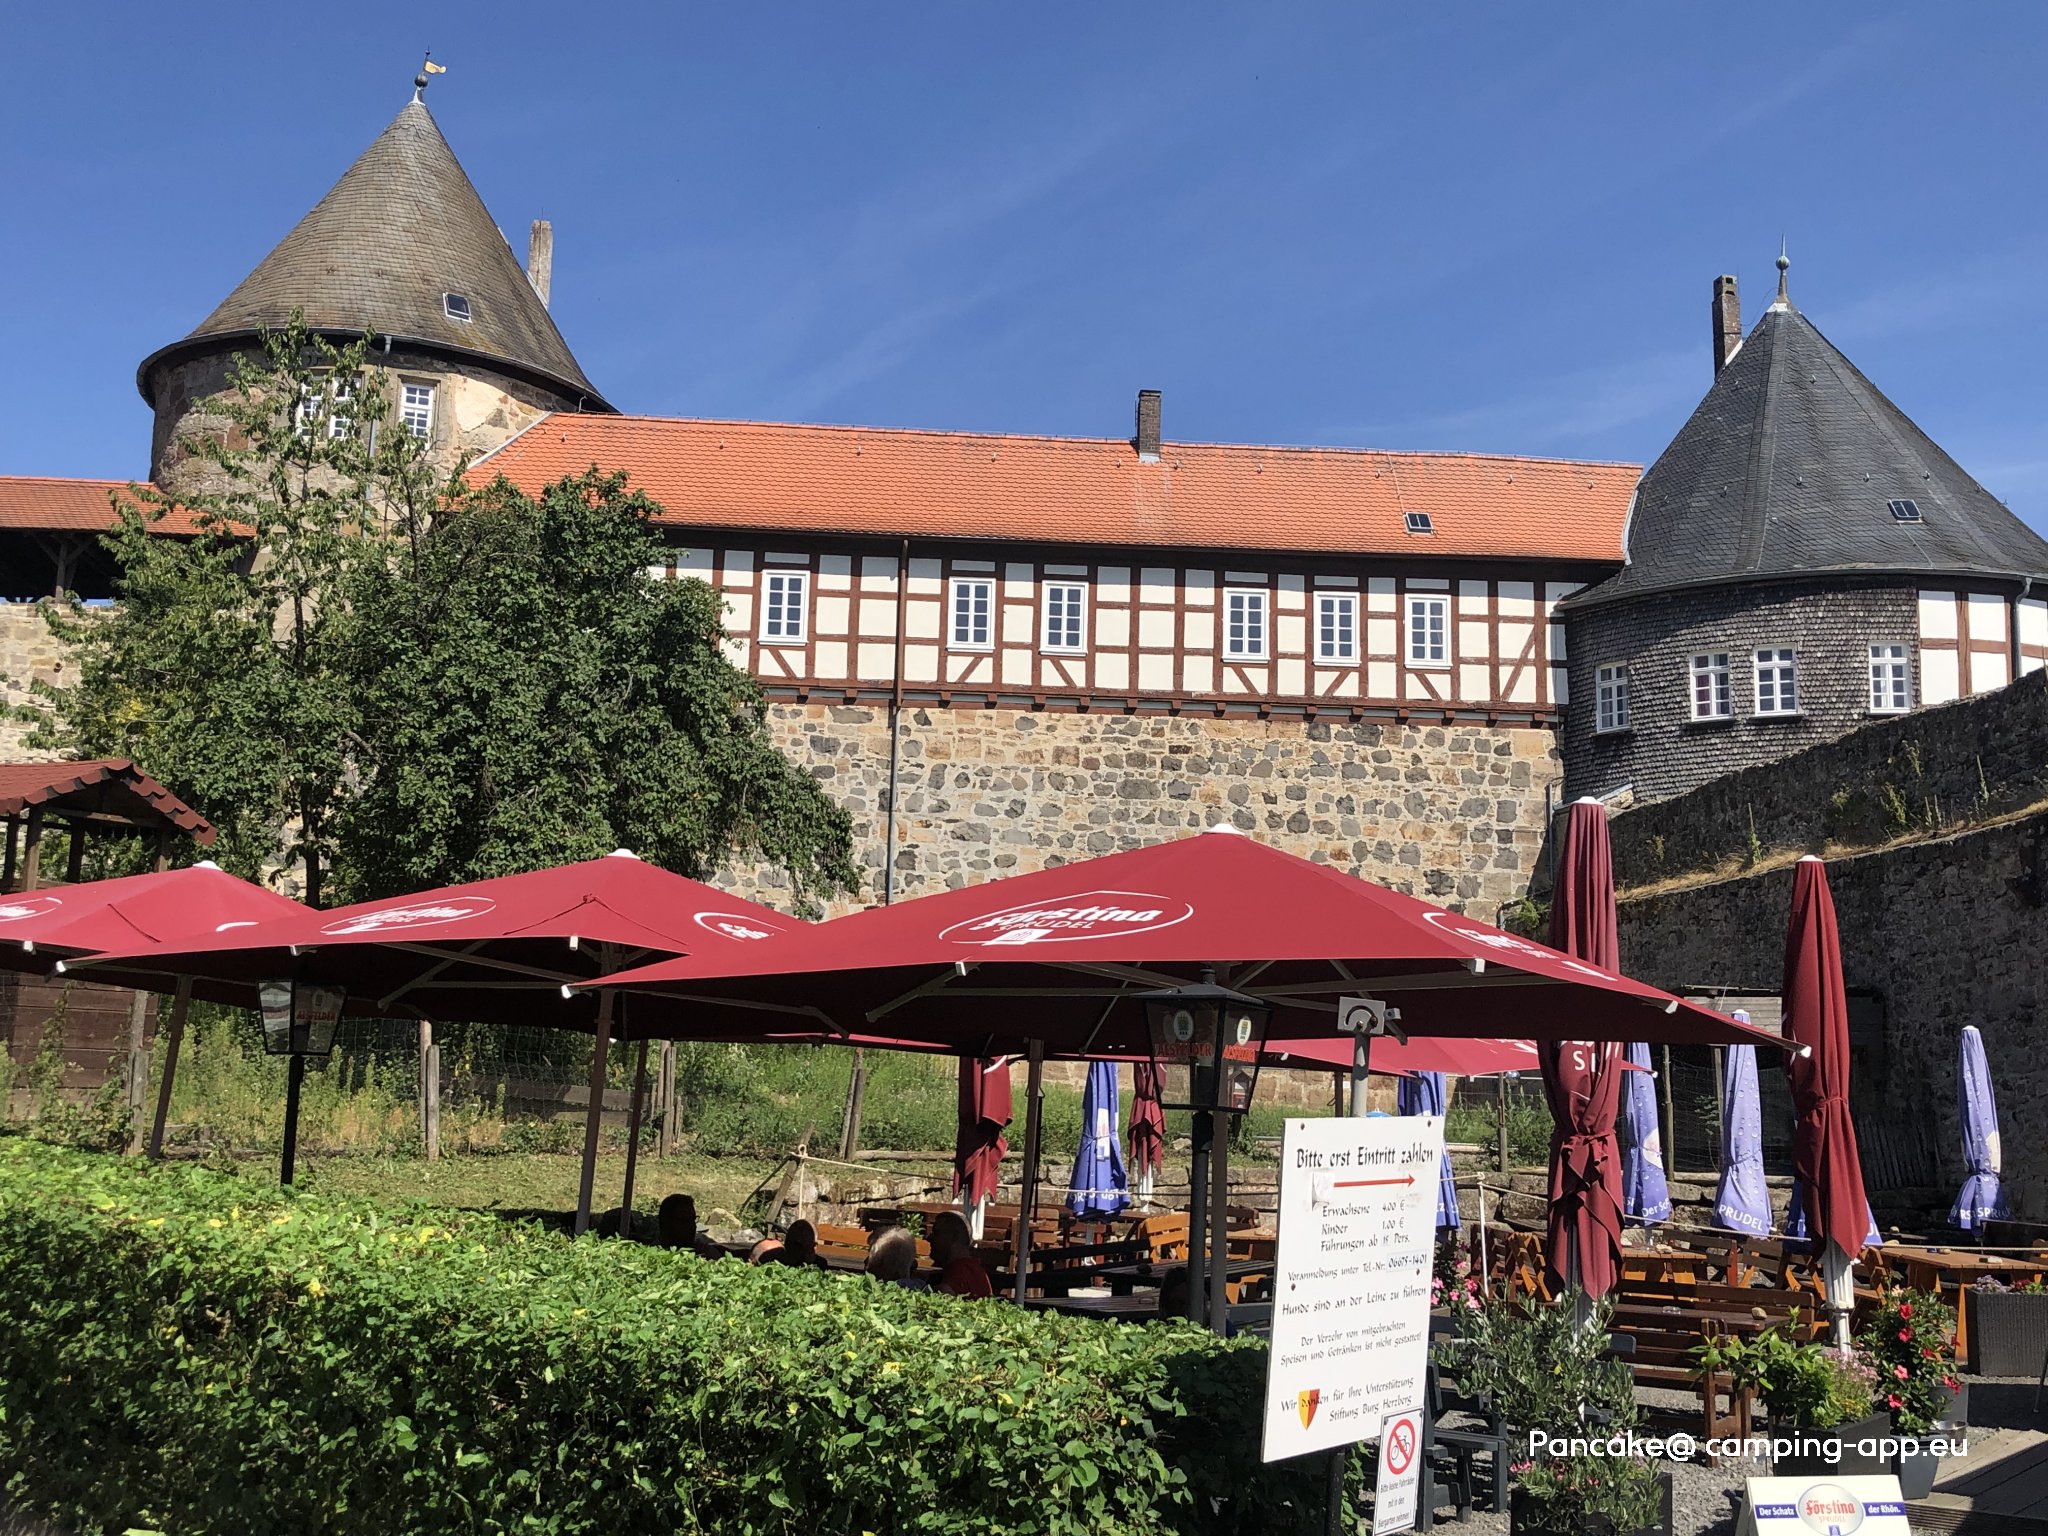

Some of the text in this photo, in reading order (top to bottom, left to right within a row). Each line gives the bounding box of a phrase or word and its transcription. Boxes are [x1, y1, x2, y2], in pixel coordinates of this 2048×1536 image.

[1296, 1141, 1433, 1168] Bitte erst Eintritt zahlen
[1322, 1202, 1371, 1217] Erwachsene
[1399, 1199, 1405, 1211] €
[1719, 1204, 1763, 1231] PRUDEL
[1321, 1217, 1405, 1235] Kinder 1.00 €
[1320, 1238, 1365, 1252] Führungen
[1368, 1234, 1378, 1247] ab
[1394, 1232, 1410, 1244] Pers.
[1288, 1267, 1338, 1281] Voranmeldung
[1341, 1266, 1359, 1276] unter
[1282, 1284, 1427, 1316] Hunde sind an der Leine zu führen
[1301, 1320, 1406, 1347] Der Verzehr von mitgebrachten
[1280, 1353, 1307, 1367] Speisen
[1310, 1350, 1324, 1360] und
[1327, 1343, 1362, 1357] Getränken
[1365, 1340, 1373, 1350] ist
[1375, 1336, 1392, 1349] nicht
[1280, 1377, 1414, 1412] Wir danken für Ihre Unterstützung
[1329, 1394, 1412, 1422] Stiftung Burg Herzberg
[1758, 1507, 1795, 1516] Der Schatz
[1805, 1499, 1856, 1516] Förstina
[1868, 1504, 1902, 1514] der Rhön.
